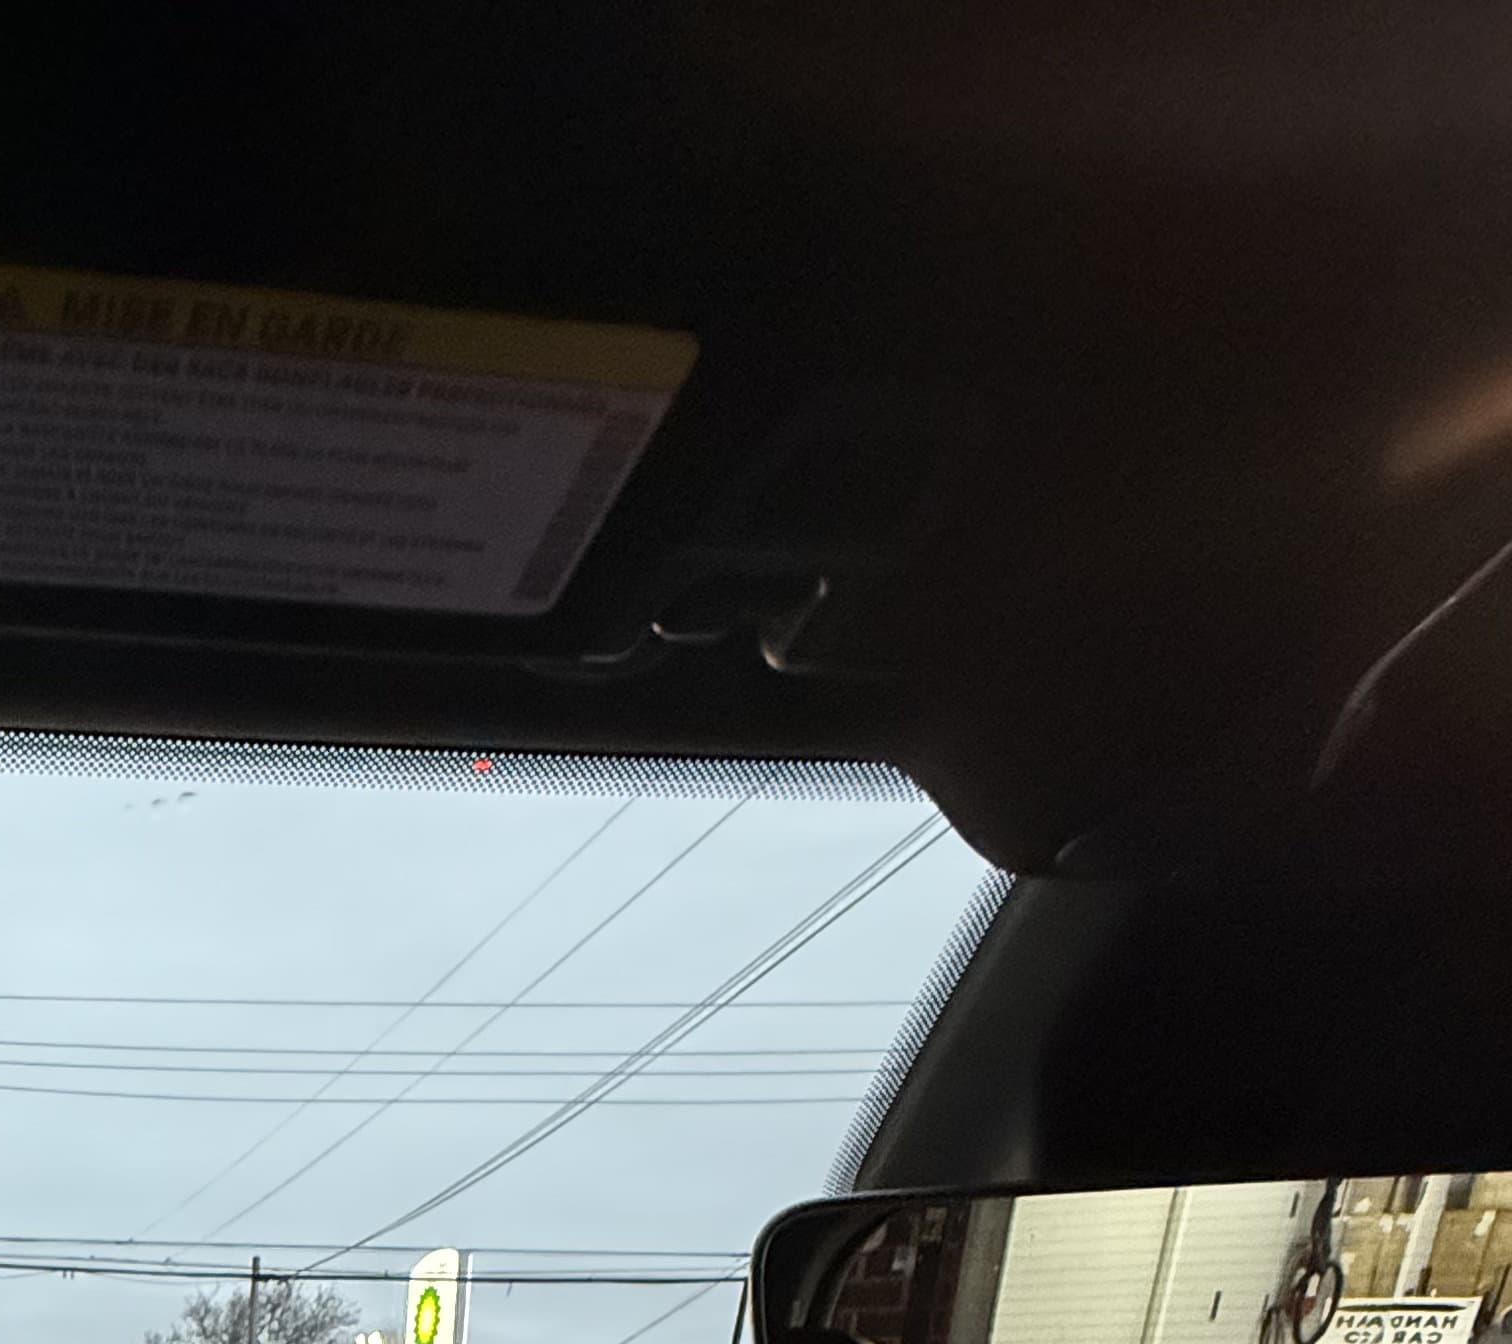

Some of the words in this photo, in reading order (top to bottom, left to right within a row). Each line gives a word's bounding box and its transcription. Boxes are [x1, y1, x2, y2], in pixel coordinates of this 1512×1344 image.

[60, 291, 172, 335] MISE
[185, 300, 249, 341] EN
[257, 306, 414, 356] GARDE
